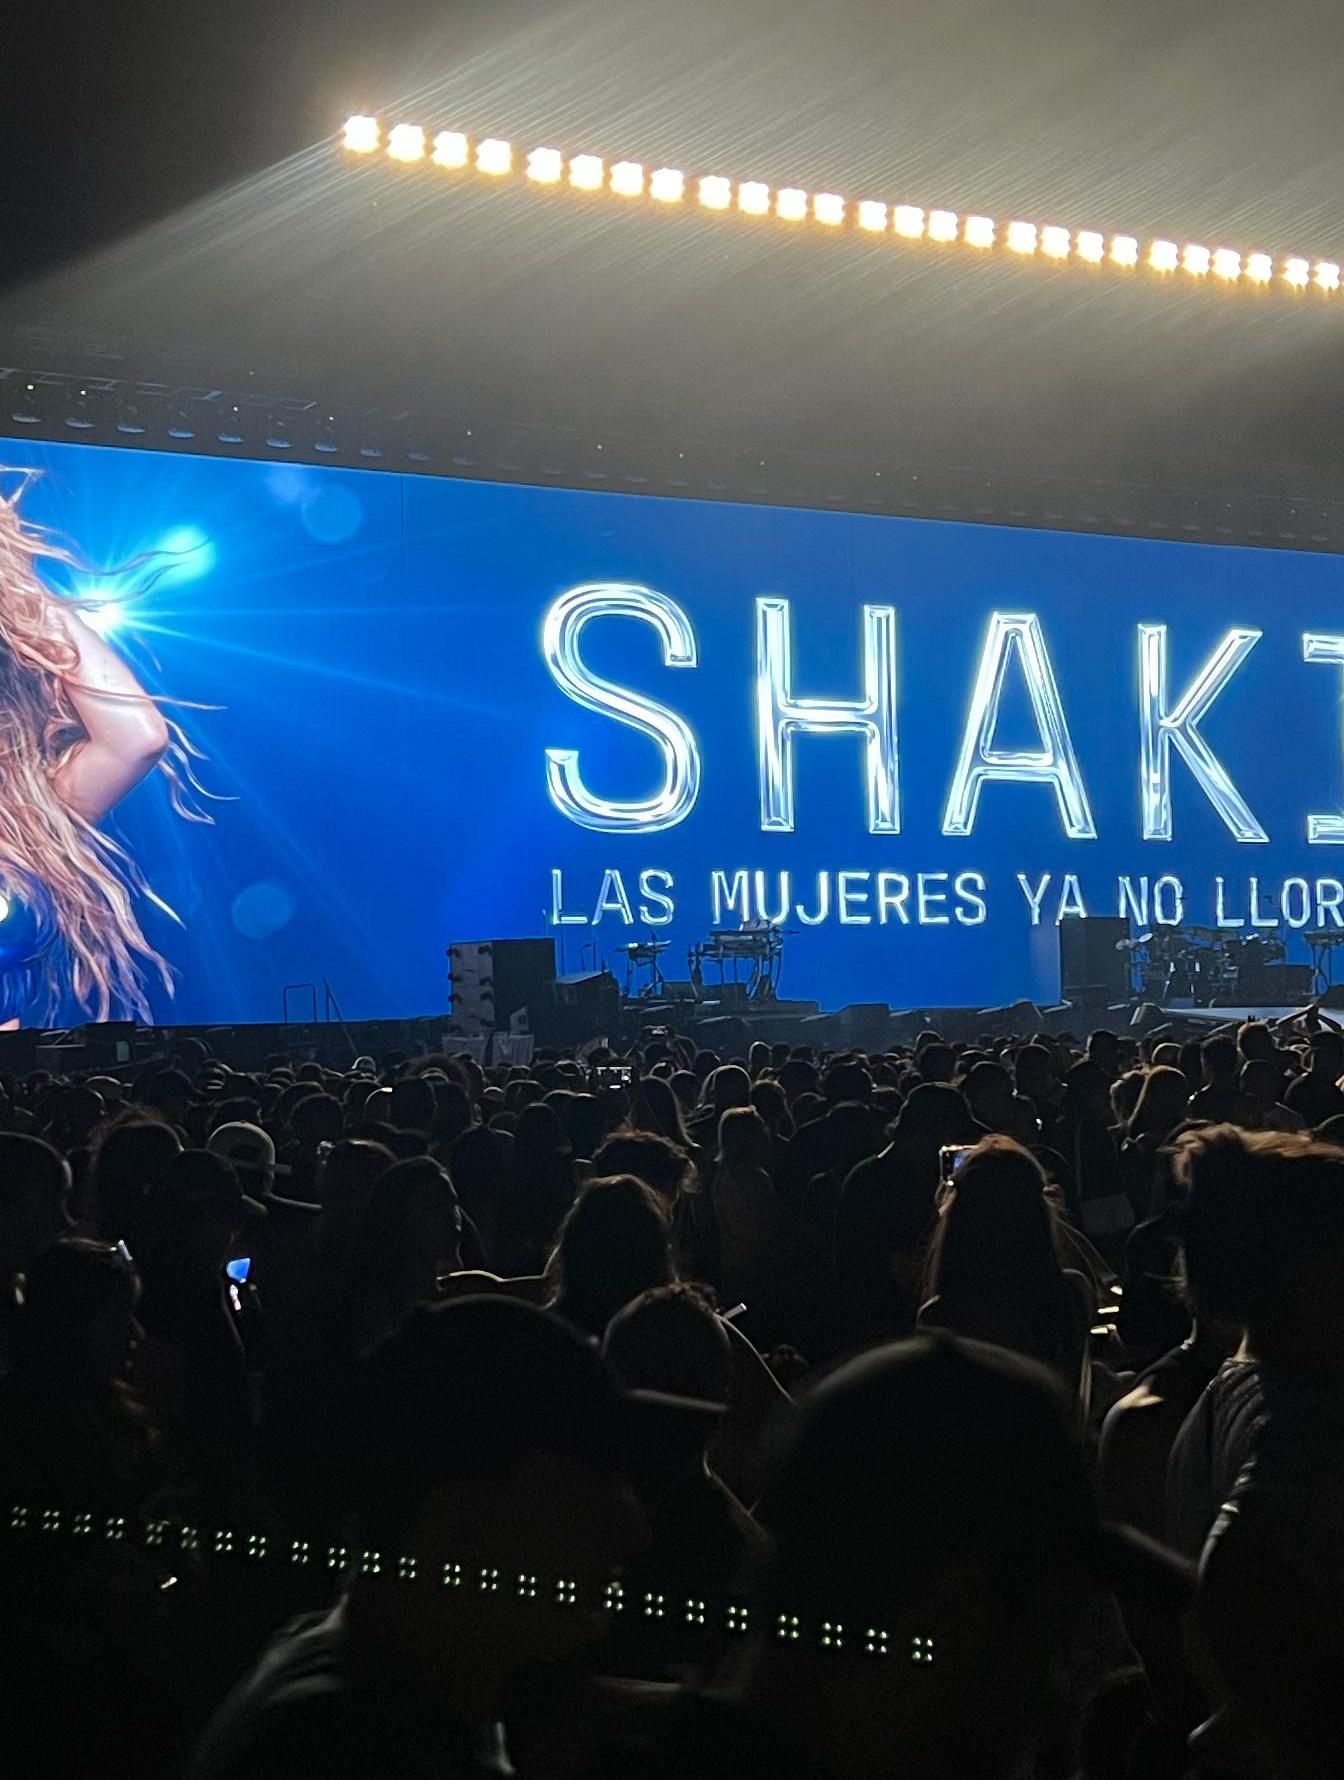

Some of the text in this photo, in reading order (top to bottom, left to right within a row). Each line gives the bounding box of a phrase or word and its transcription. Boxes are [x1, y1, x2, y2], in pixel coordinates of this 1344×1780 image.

[551, 868, 675, 925] LAS
[711, 869, 987, 926] MUJERES
[1017, 873, 1089, 926] YA
[1118, 875, 1183, 927] NO
